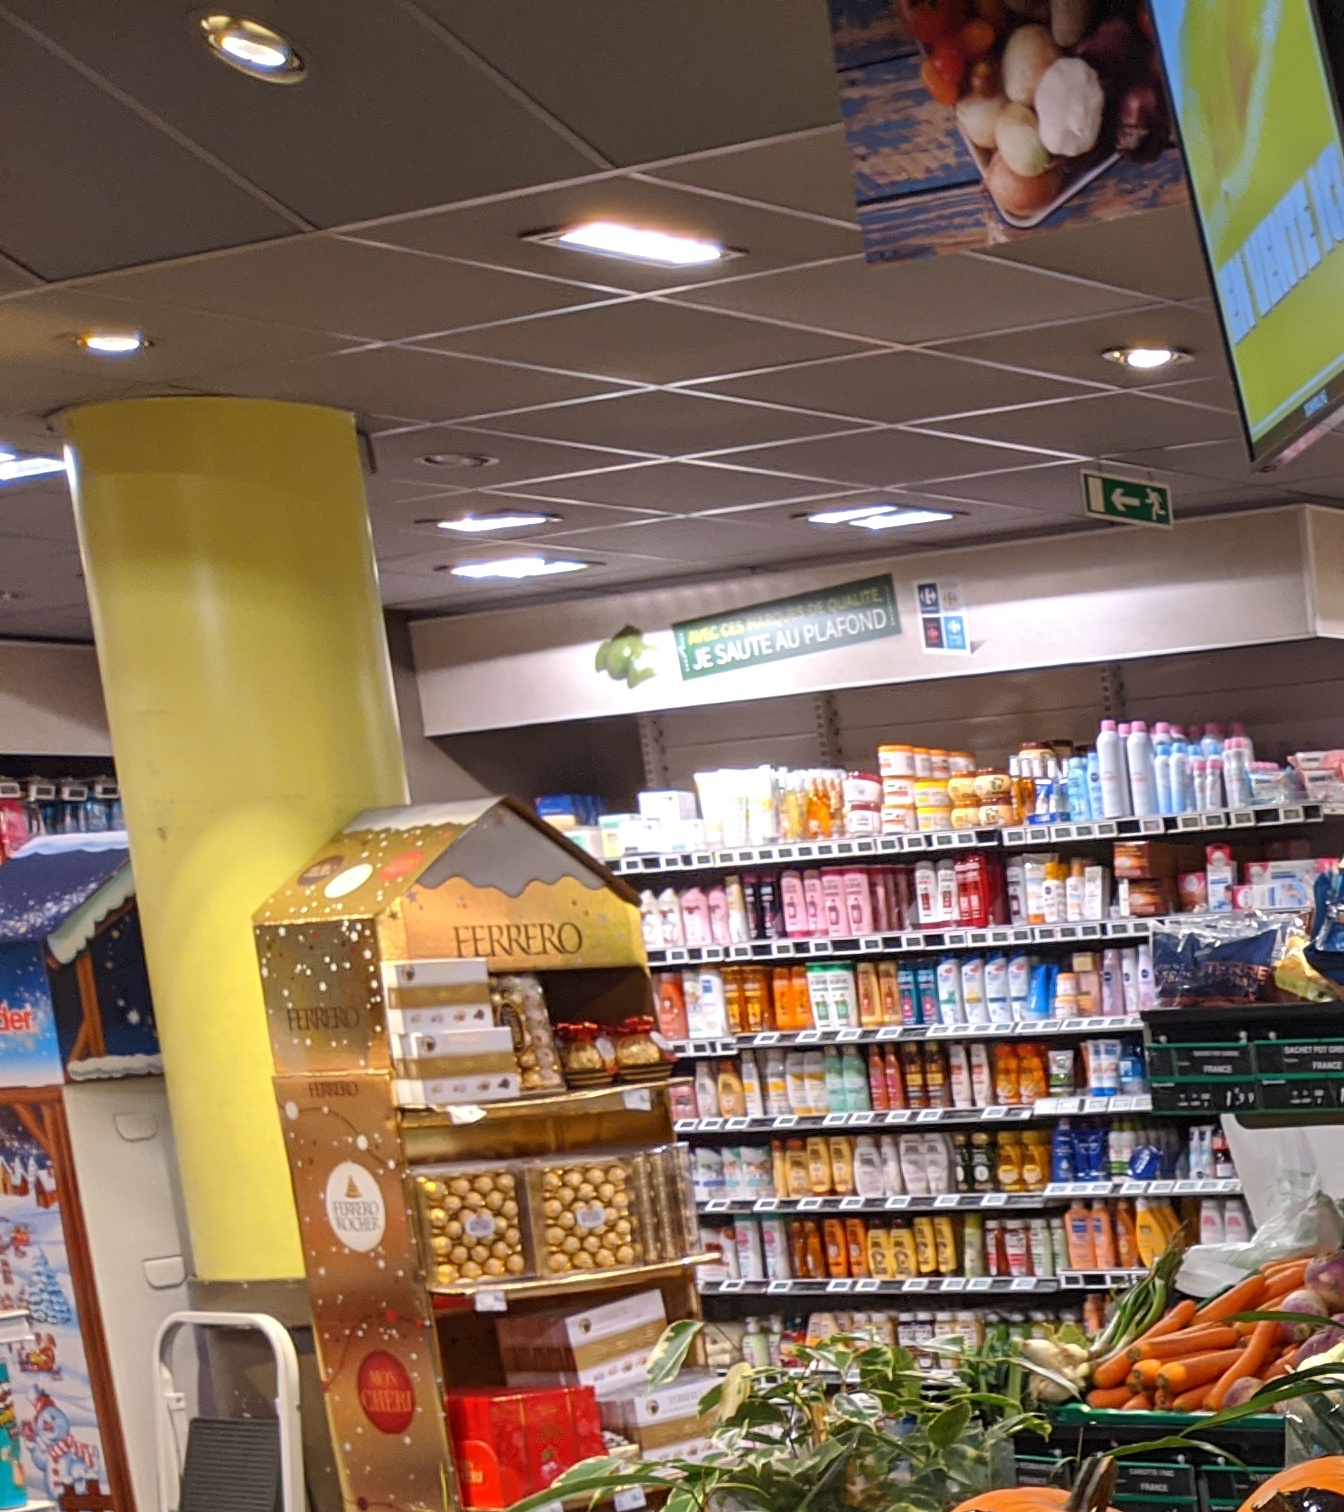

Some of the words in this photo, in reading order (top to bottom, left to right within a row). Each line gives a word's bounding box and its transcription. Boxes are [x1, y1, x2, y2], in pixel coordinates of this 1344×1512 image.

[1217, 253, 1257, 345] EN
[1242, 178, 1322, 318] VENTE
[693, 647, 714, 671] JE
[715, 635, 773, 665] SAUTE
[776, 628, 800, 651] AU
[805, 608, 888, 645] PLAFOND
[453, 921, 583, 958] FERRERO
[287, 1005, 360, 1032] FERRERO
[1203, 1064, 1233, 1074] FRANCE
[1312, 1060, 1343, 1070] FRANCE
[309, 1080, 360, 1097] FERRERO
[334, 1201, 380, 1216] FERRERO
[338, 1217, 380, 1232] ROCHER
[1140, 1482, 1168, 1493] FRANCE
